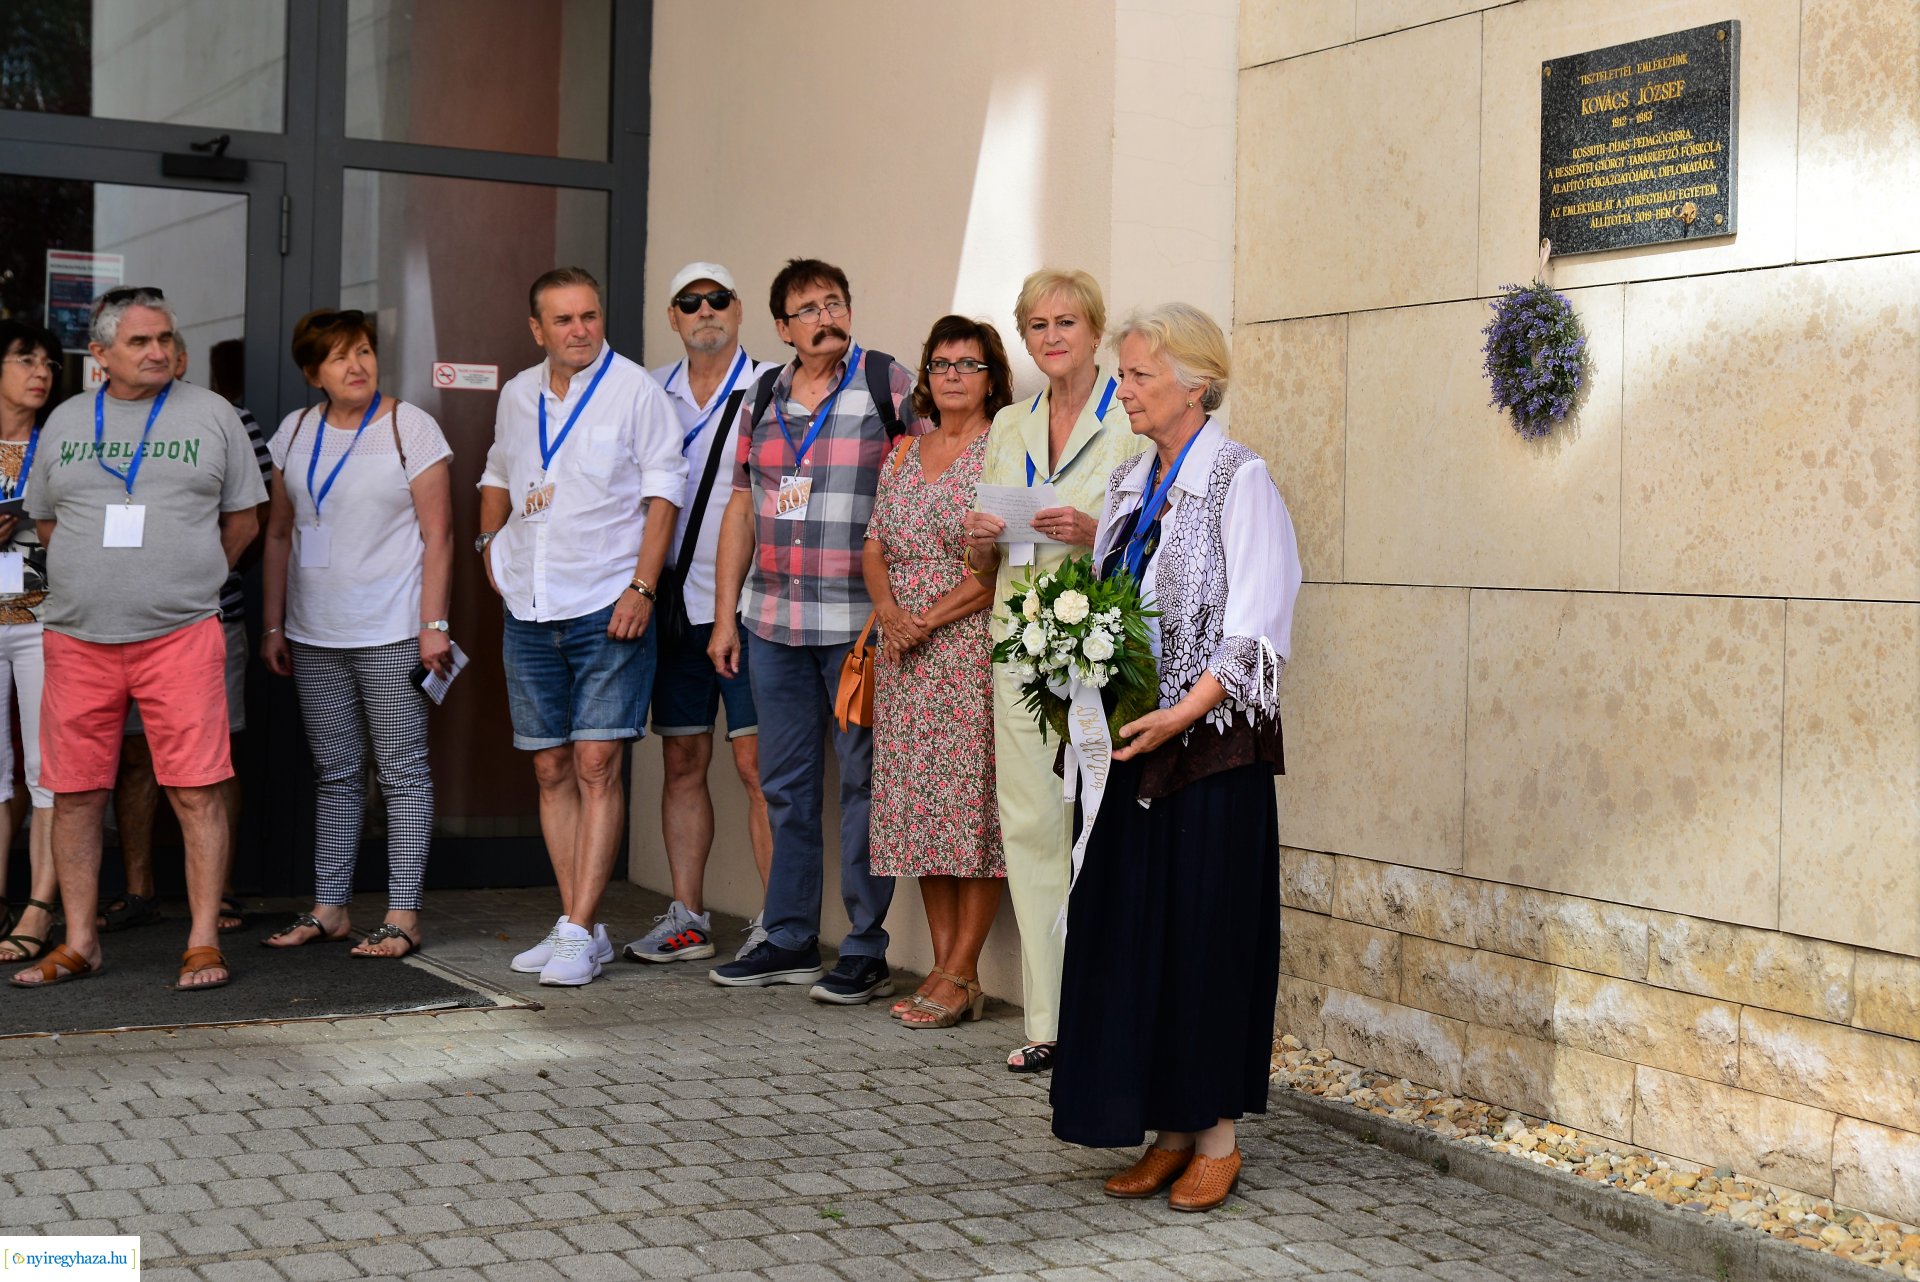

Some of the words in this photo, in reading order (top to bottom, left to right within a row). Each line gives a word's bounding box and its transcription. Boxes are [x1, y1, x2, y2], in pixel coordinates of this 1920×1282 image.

[1580, 65, 1632, 86] TISZTELETTEL
[1637, 53, 1688, 74] EMLÉKEZÜNK
[1581, 89, 1630, 116] KOVÁCS
[1637, 80, 1686, 106] JÓZSEF
[1611, 116, 1628, 128] 1912
[1636, 111, 1653, 124] 1983
[1548, 168, 1553, 179] A
[1555, 161, 1593, 178] BESSENYEI
[1595, 156, 1625, 171] GYÖRGY
[1629, 145, 1679, 166] TANÁRKÉPZŐ
[1681, 140, 1721, 157] FŐISKOLA
[1550, 207, 1560, 218] AZ
[1562, 197, 1614, 217] EMLÉKTÁBLÁT
[1616, 198, 1622, 209] A
[1625, 189, 1676, 208] NYÍREGYHÁZI
[1679, 183, 1717, 200] EGYETEM
[1590, 213, 1632, 229] ÁLLÍTOTTA
[60, 438, 200, 468] WIMBLEDON
